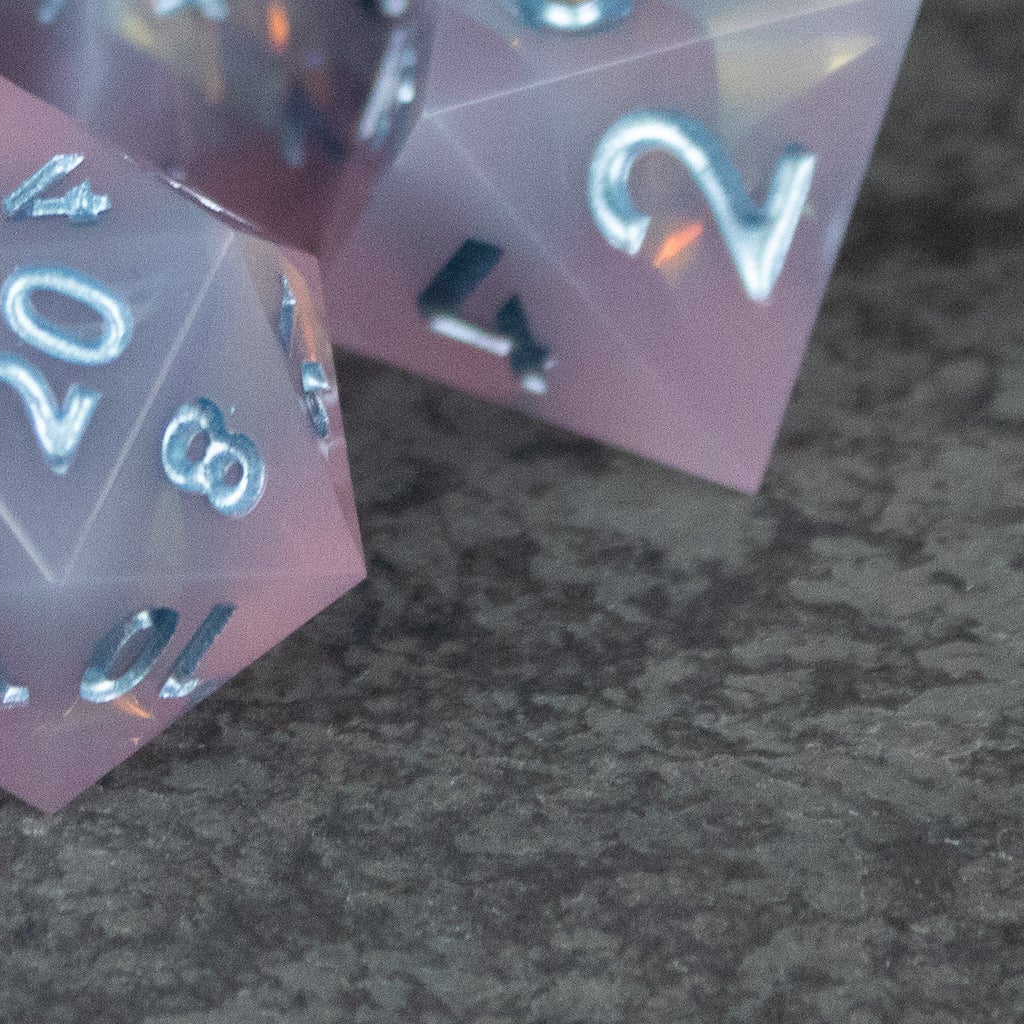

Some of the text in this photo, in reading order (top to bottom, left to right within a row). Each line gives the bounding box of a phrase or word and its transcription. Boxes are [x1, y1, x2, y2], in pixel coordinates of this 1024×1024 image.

[586, 111, 818, 304] 2
[416, 236, 558, 398] 4
[162, 396, 268, 518] 8
[79, 603, 238, 704] 10
